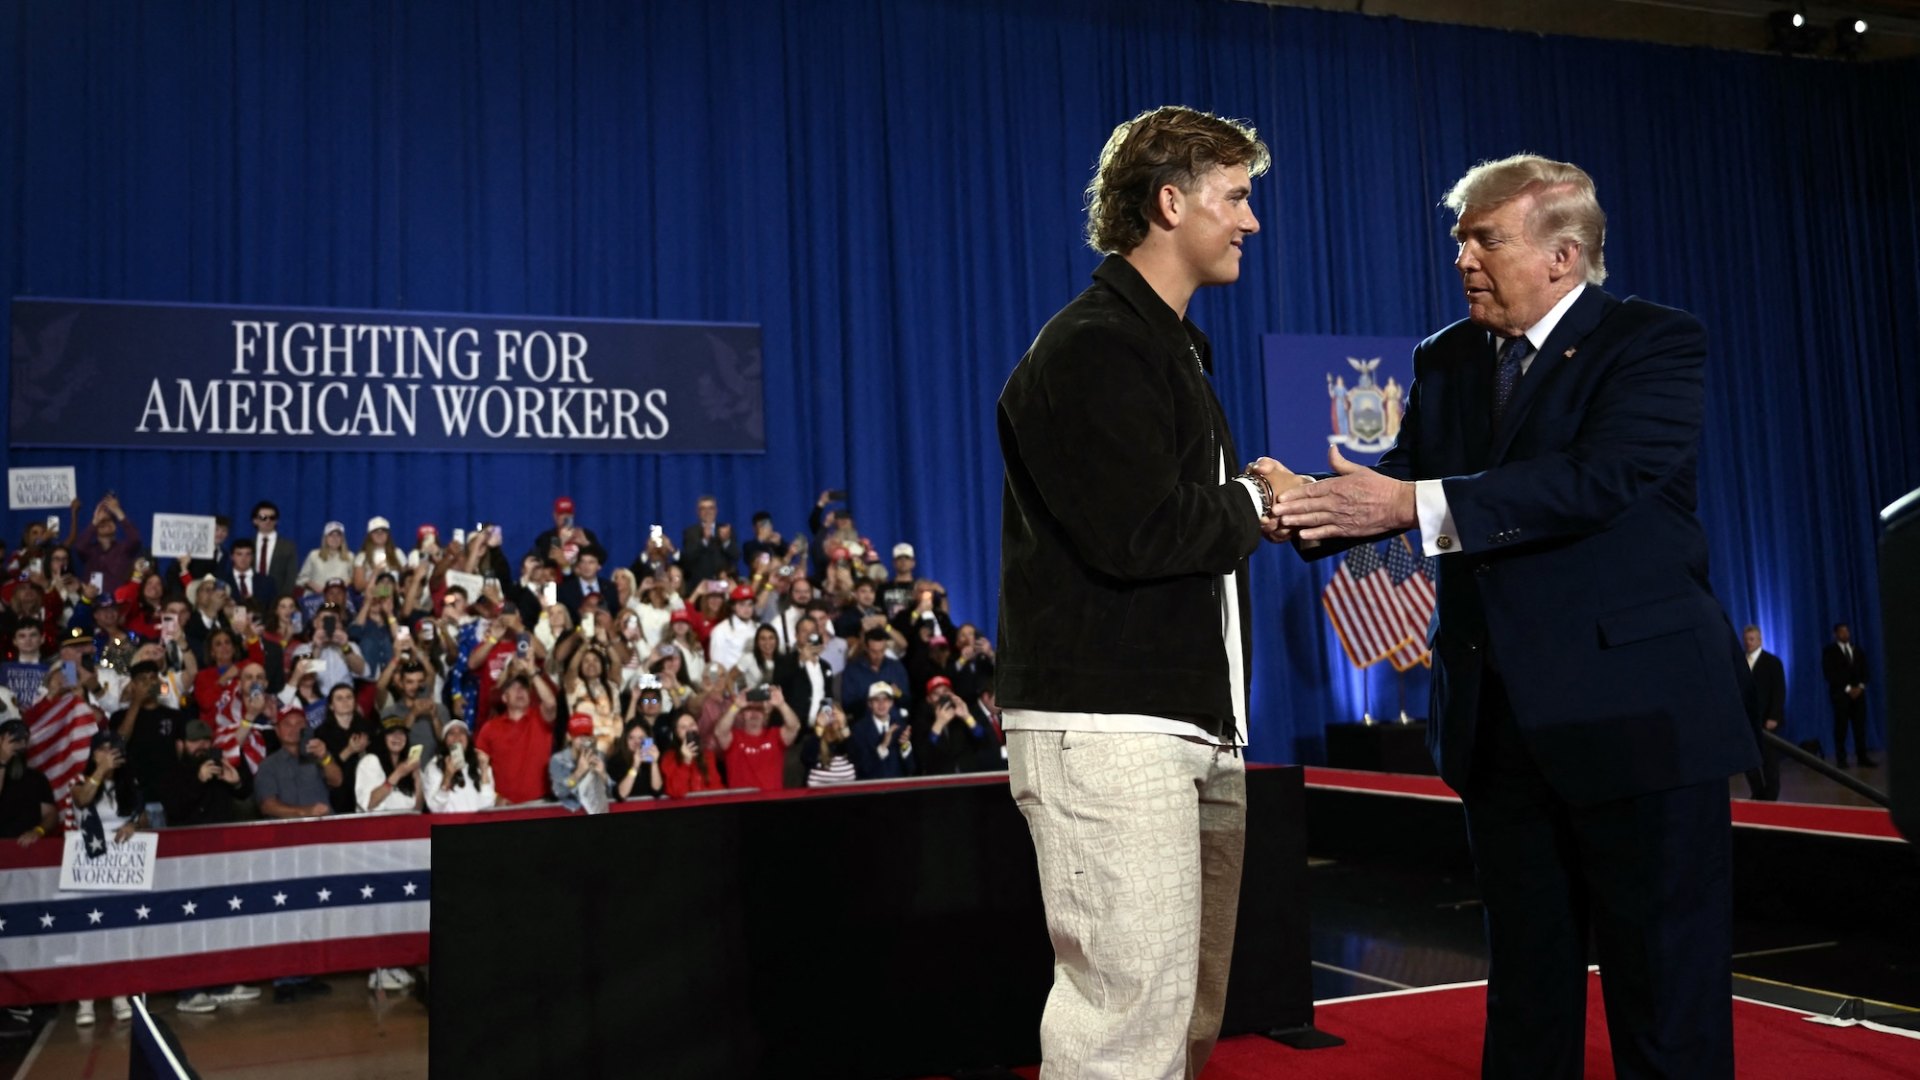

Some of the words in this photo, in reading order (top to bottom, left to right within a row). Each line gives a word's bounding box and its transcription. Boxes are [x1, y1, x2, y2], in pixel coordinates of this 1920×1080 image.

[233, 320, 482, 381] FIGHTING
[495, 329, 594, 384] FOR
[136, 378, 420, 437] AMERICAN
[431, 384, 670, 440] WORKERS
[127, 841, 147, 852] FOR
[72, 853, 146, 867] AMERICAN
[72, 868, 144, 885] WORKERS
